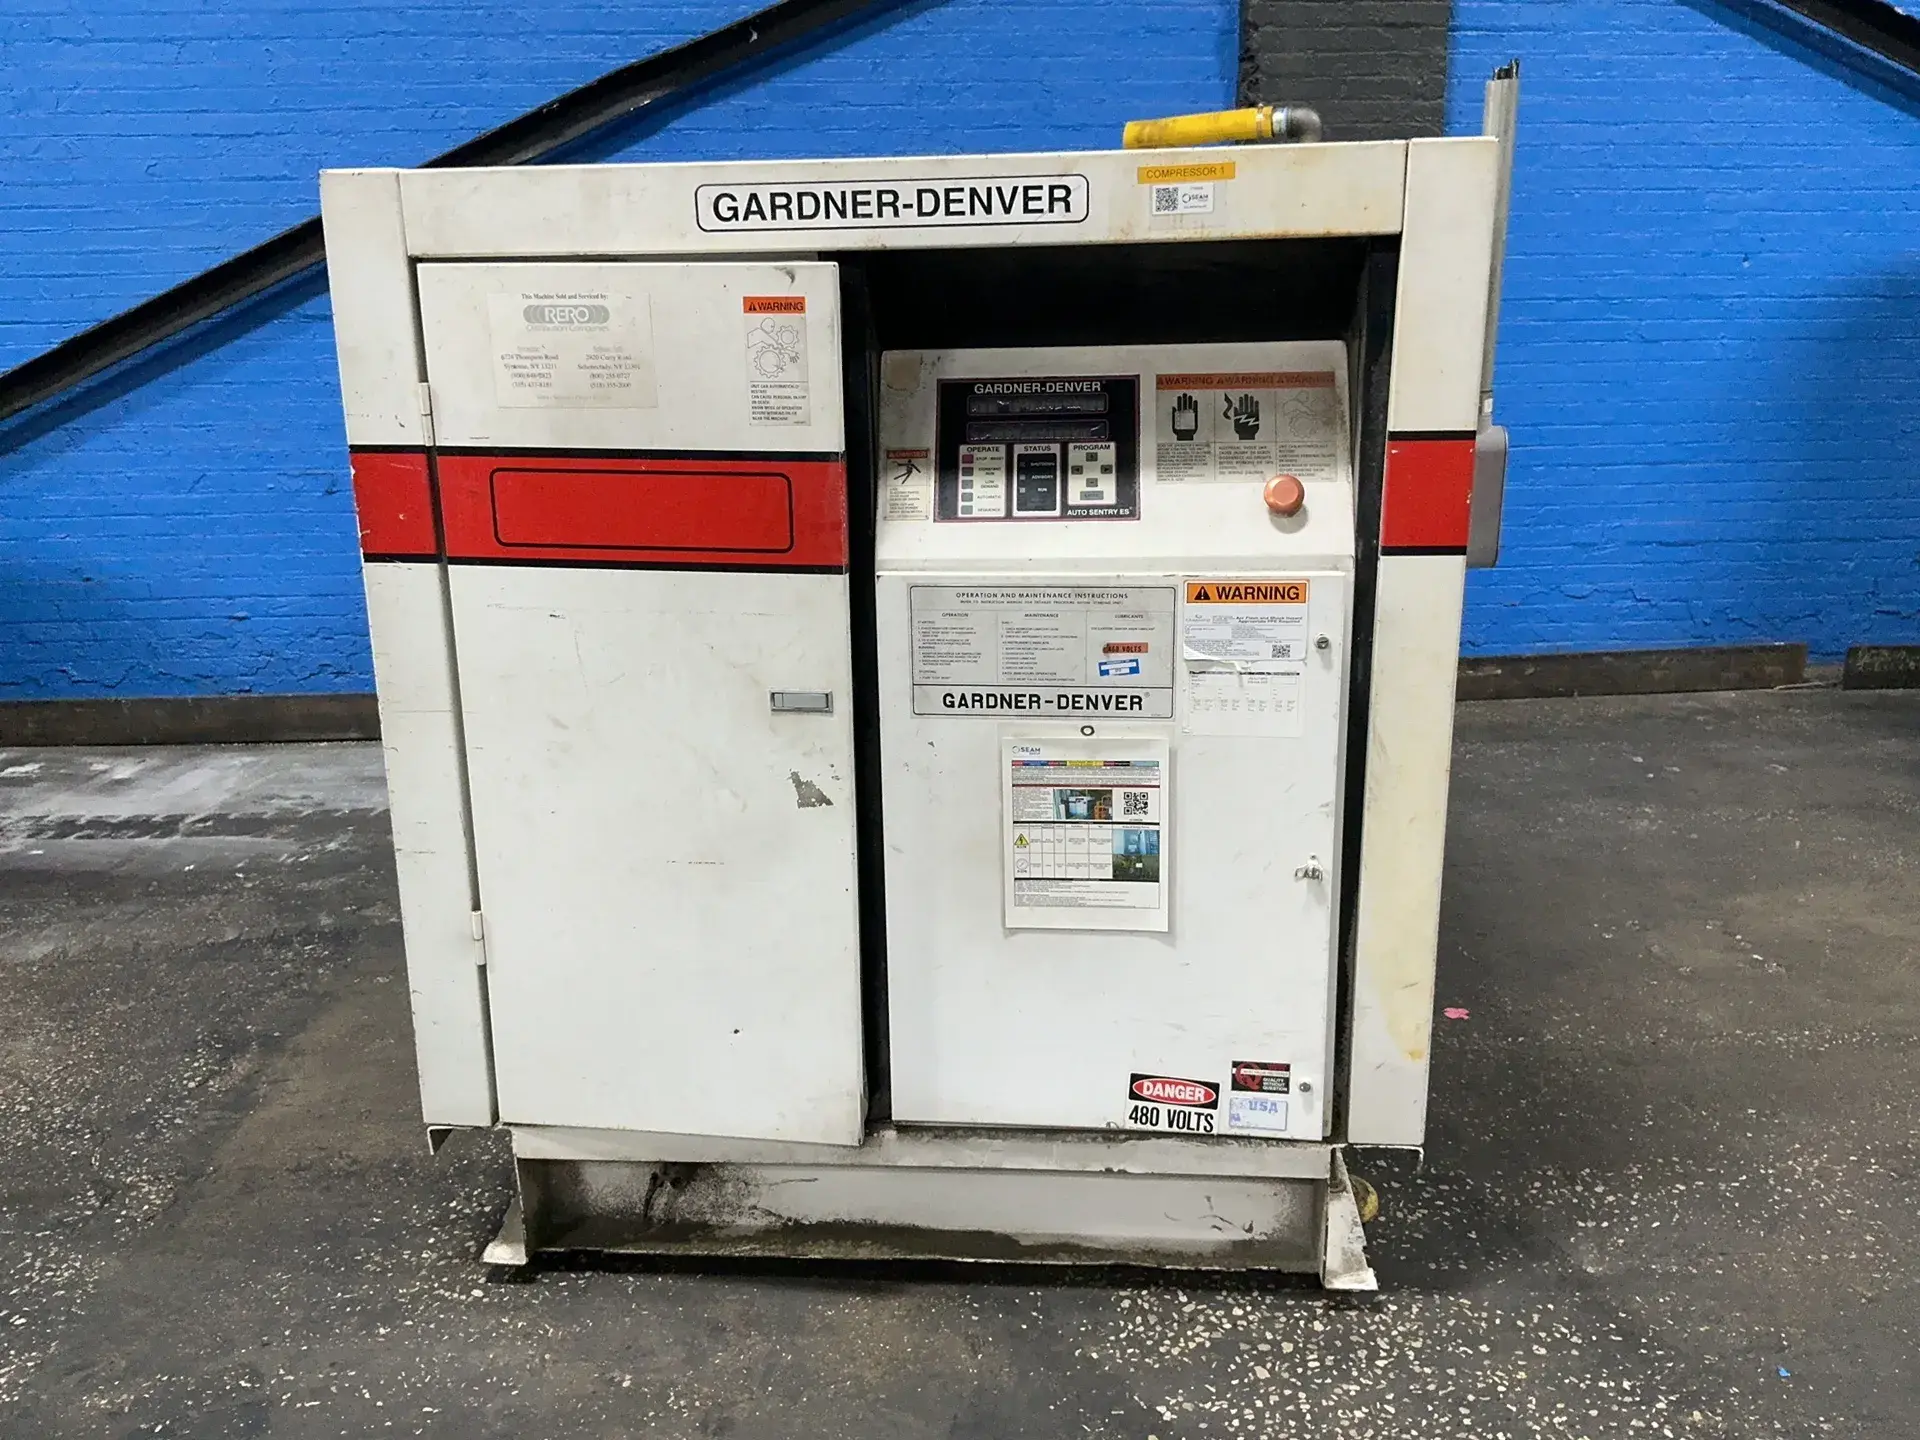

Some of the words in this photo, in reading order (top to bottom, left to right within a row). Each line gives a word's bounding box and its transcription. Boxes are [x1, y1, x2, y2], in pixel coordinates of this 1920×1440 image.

[1146, 166, 1217, 179] COMPRESSOR
[1220, 166, 1225, 175] 1
[713, 184, 1072, 223] GARDNER-DENVER
[757, 301, 804, 311] WARNING
[544, 306, 590, 322] RERO
[974, 381, 1101, 394] GARDNER-DENVER
[1165, 376, 1213, 386] WARNING
[1224, 375, 1273, 385] WARNING
[1088, 508, 1119, 516] SENTRY
[1215, 585, 1300, 600] WARNING
[1121, 645, 1142, 653] VOLTS
[942, 692, 1143, 711] GARDNER-DENVER
[1142, 1081, 1205, 1102] DANGER
[1248, 1099, 1278, 1114] USA
[1128, 1104, 1160, 1127] 480
[1167, 1108, 1214, 1133] VOLTS
